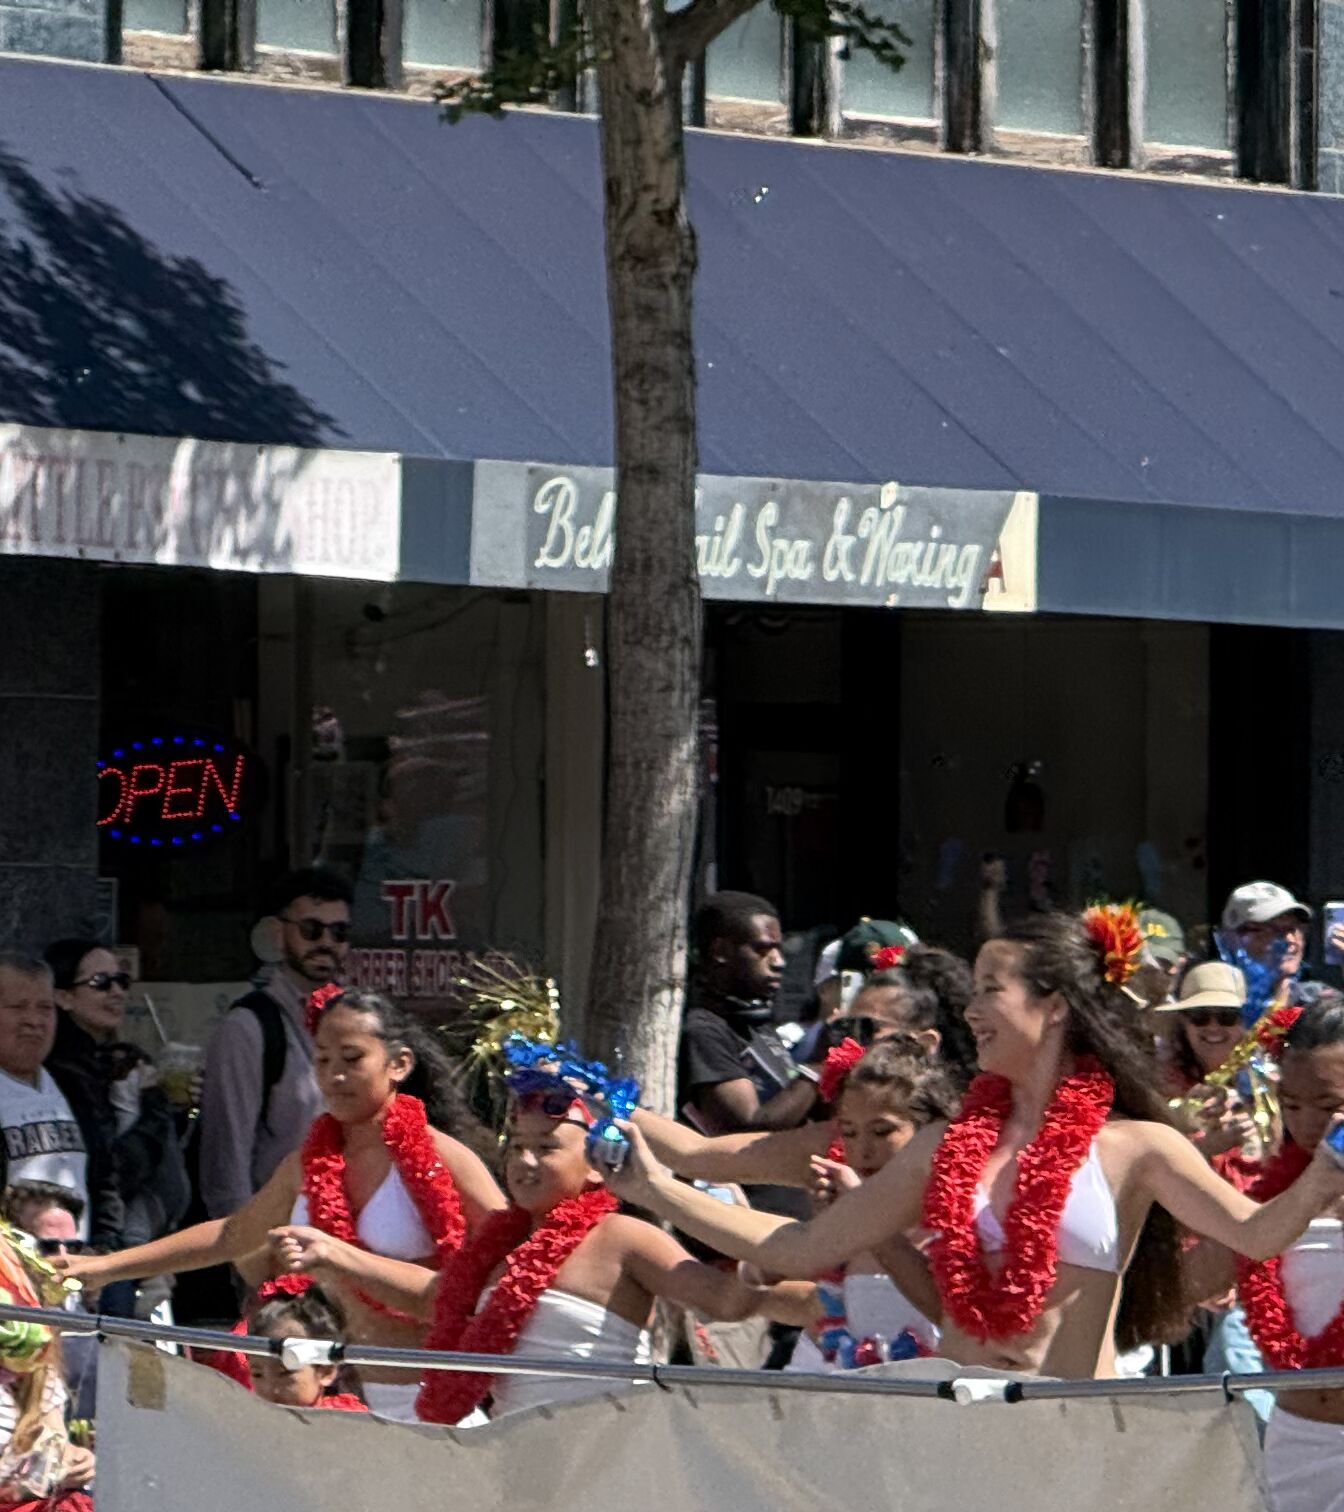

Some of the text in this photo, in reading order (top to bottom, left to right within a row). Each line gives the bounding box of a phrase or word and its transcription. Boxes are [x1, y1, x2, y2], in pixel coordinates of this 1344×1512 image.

[534, 476, 983, 606] Bel ail Spa & Waxing
[97, 755, 245, 826] OPEN
[382, 879, 457, 940] TK
